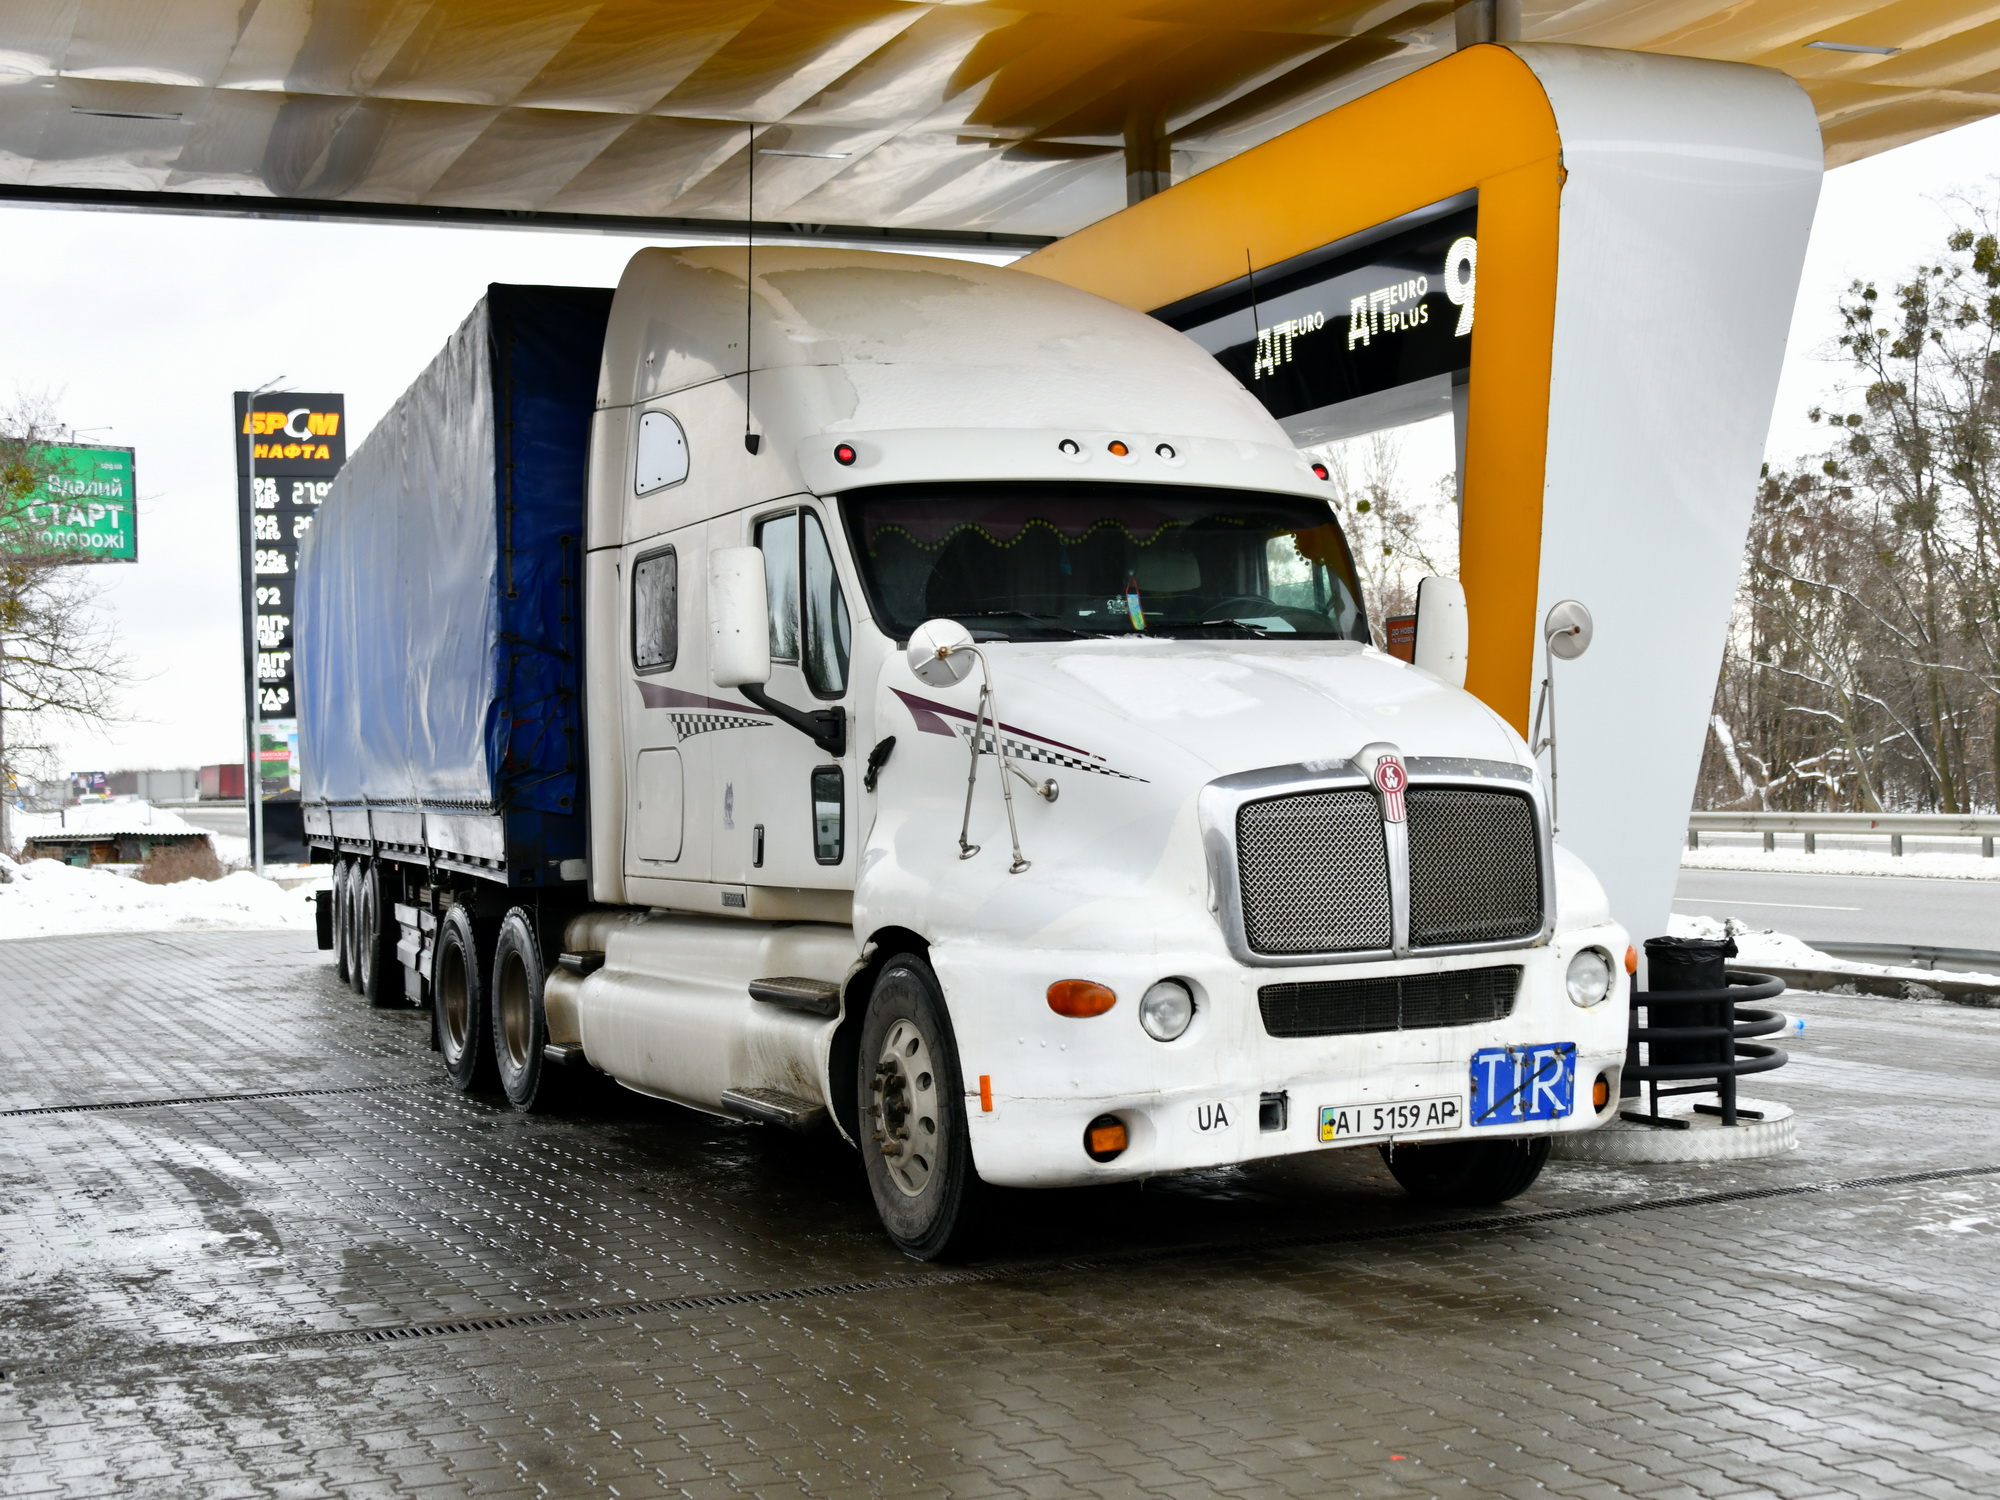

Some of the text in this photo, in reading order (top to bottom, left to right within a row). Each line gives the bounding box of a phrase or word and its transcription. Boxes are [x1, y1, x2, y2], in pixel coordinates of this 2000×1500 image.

[1389, 276, 1428, 305] EURO
[1444, 236, 1478, 337] 9
[1291, 311, 1325, 338] EURO
[1391, 304, 1429, 333] PLUS
[253, 442, 330, 460] НАФТА
[27, 499, 125, 529] СТАРТ
[253, 514, 278, 532] 95
[255, 587, 282, 606] 92
[1479, 1049, 1567, 1118] TIR
[1198, 1102, 1229, 1131] UA
[1336, 1101, 1456, 1135] AI 5159 AP
